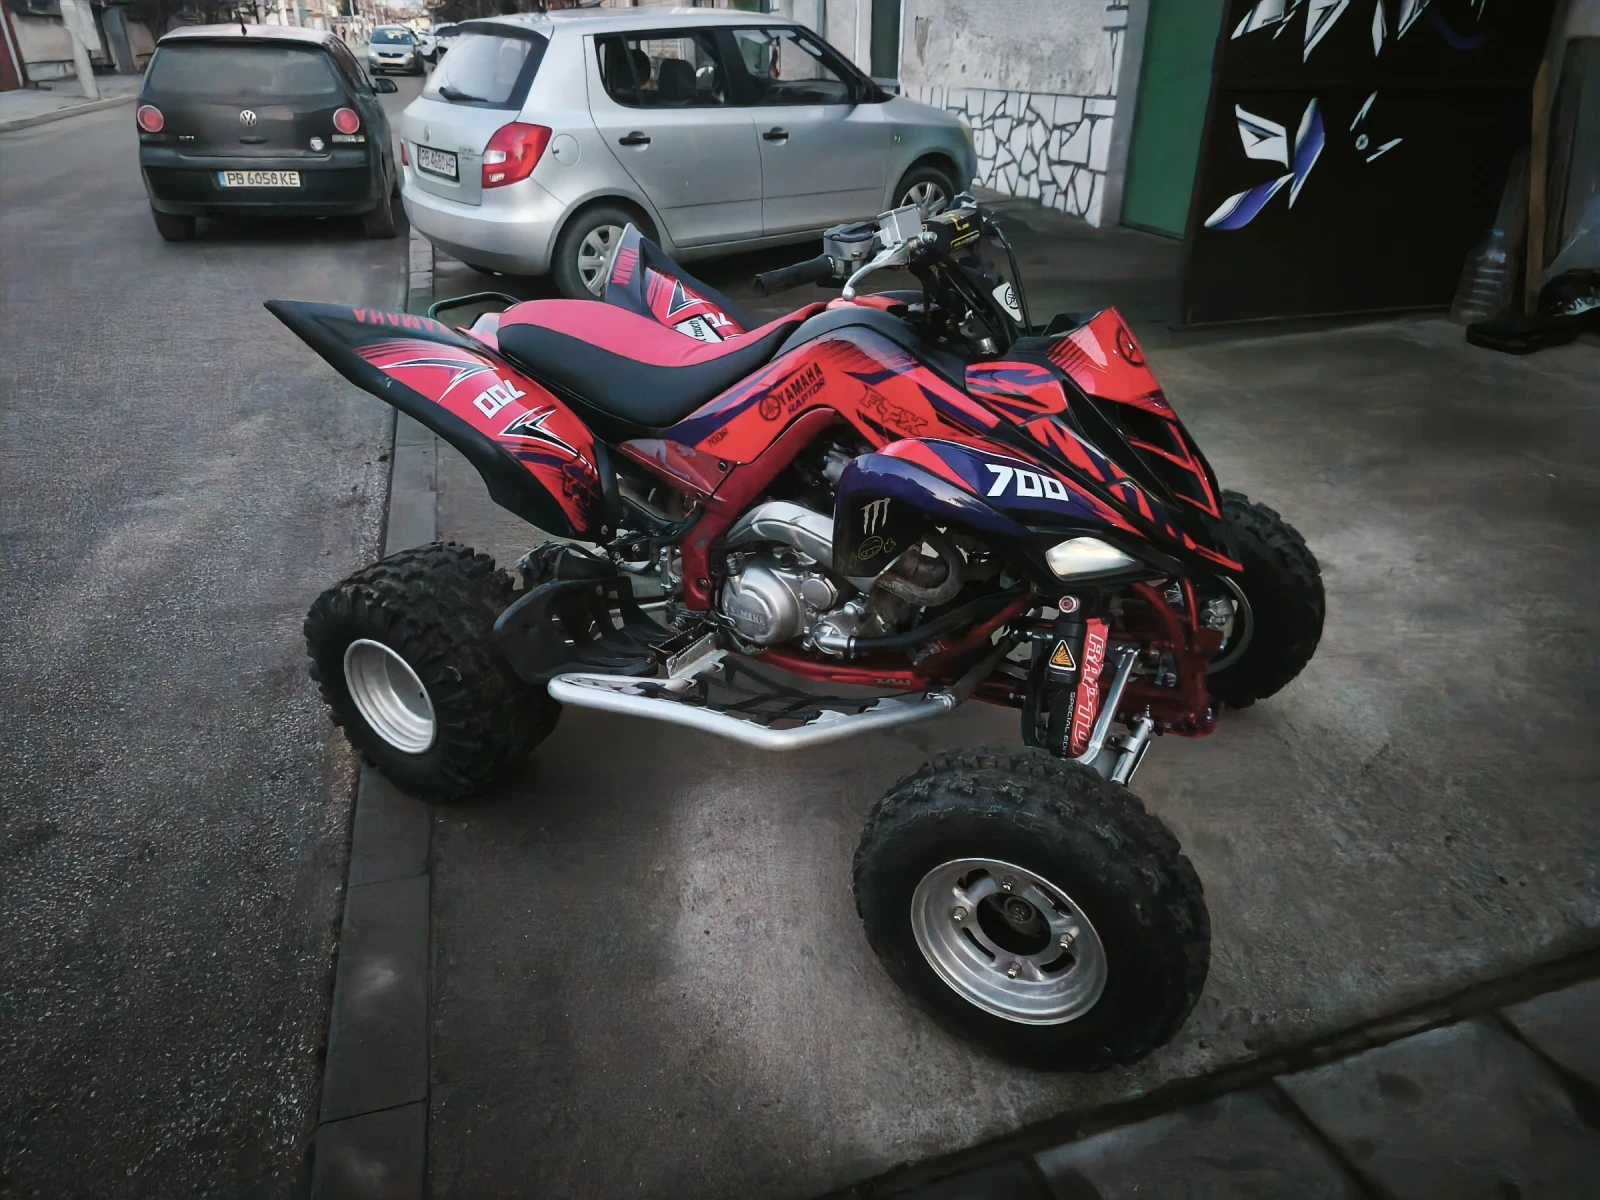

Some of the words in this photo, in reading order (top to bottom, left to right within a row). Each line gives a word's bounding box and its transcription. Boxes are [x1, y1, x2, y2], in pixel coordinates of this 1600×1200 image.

[227, 172, 245, 185] PB
[247, 171, 278, 185] 6058
[280, 172, 298, 185] KE
[702, 312, 734, 329] 70
[473, 380, 527, 420] 700
[777, 361, 823, 406] YAMAHA
[787, 378, 825, 415] RAPTOR
[707, 427, 729, 448] 700R
[985, 463, 1069, 502] 700
[1065, 691, 1076, 733] SPECIAL
[1060, 736, 1070, 759] EDIT
